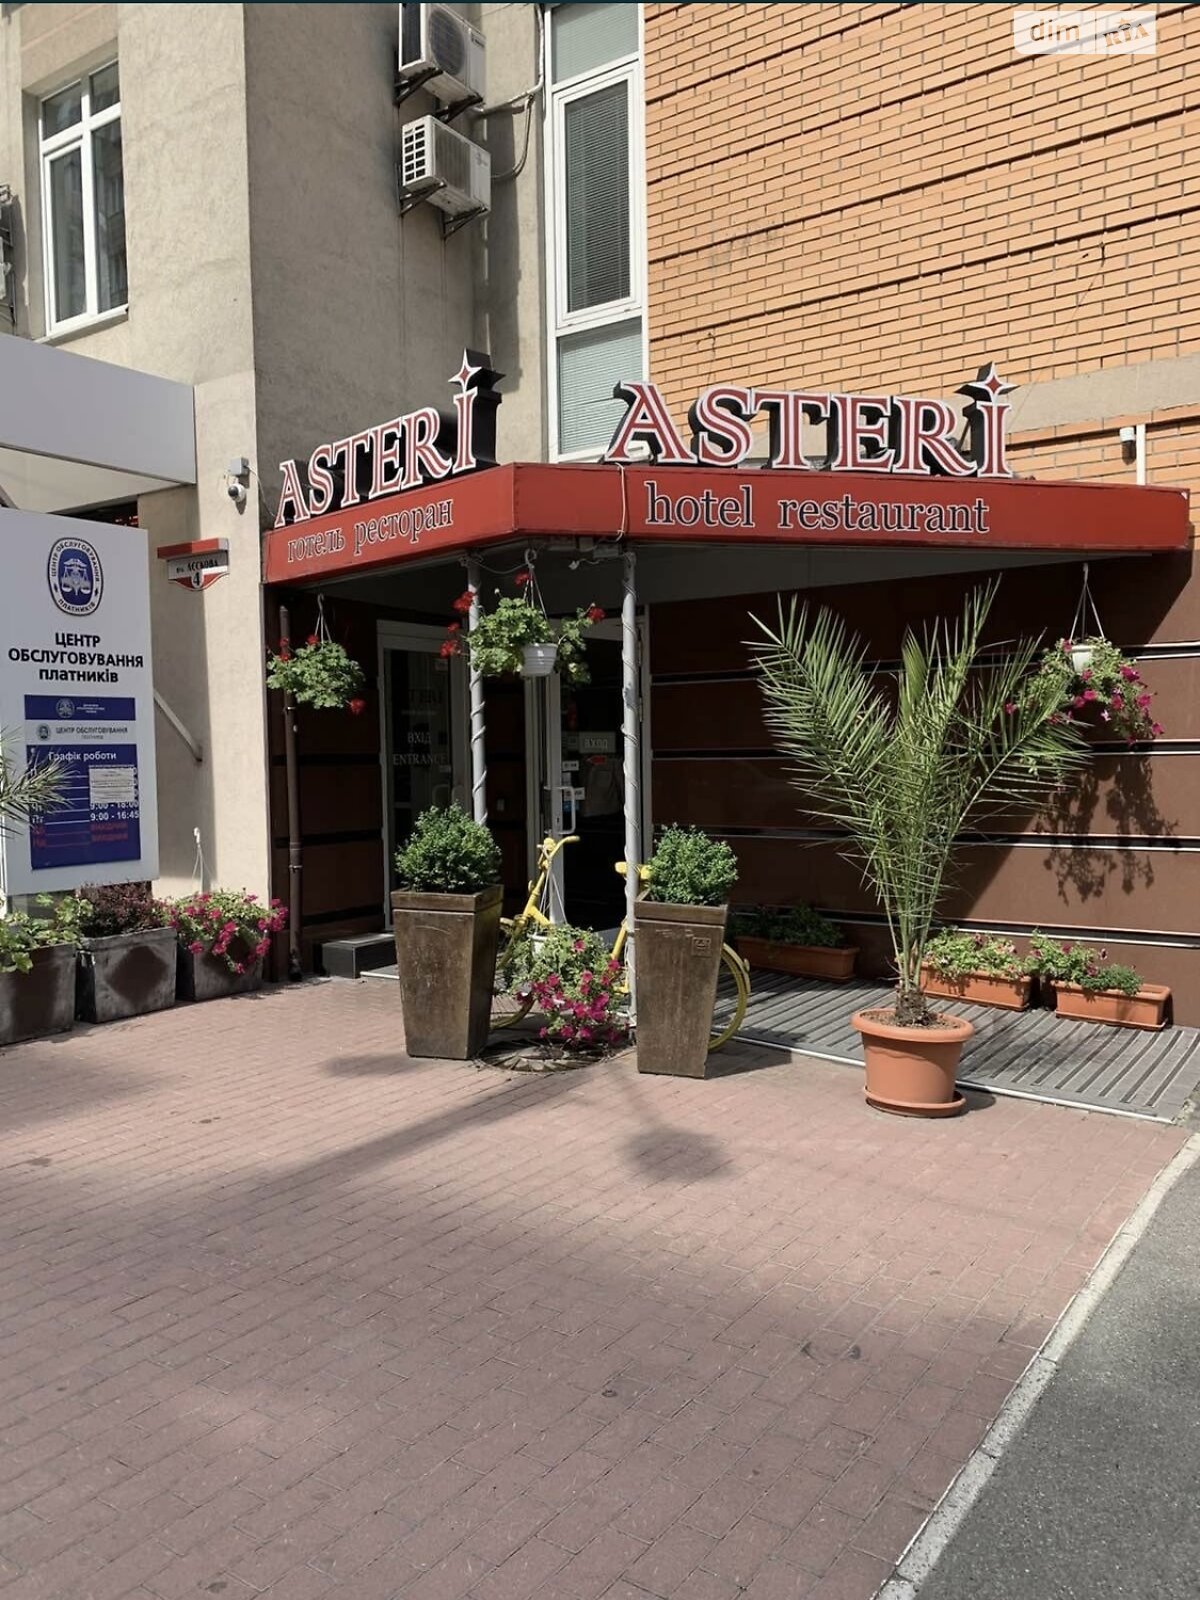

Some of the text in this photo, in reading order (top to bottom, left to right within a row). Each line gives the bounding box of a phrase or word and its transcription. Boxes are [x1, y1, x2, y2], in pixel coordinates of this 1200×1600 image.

[603, 361, 1019, 478] ASTERI
[644, 480, 991, 534] hotel restaurant
[288, 499, 454, 563] готель ресторан
[193, 572, 200, 586] 4
[55, 632, 101, 648] ЦЕНТР
[8, 648, 144, 668] ОБСЛУГОВУВАННЯ
[39, 668, 119, 683] платників
[48, 751, 117, 762] Графік роботи
[392, 753, 448, 767] ENTRANCE
[90, 812, 109, 821] 9:00
[117, 811, 139, 820] 16:45
